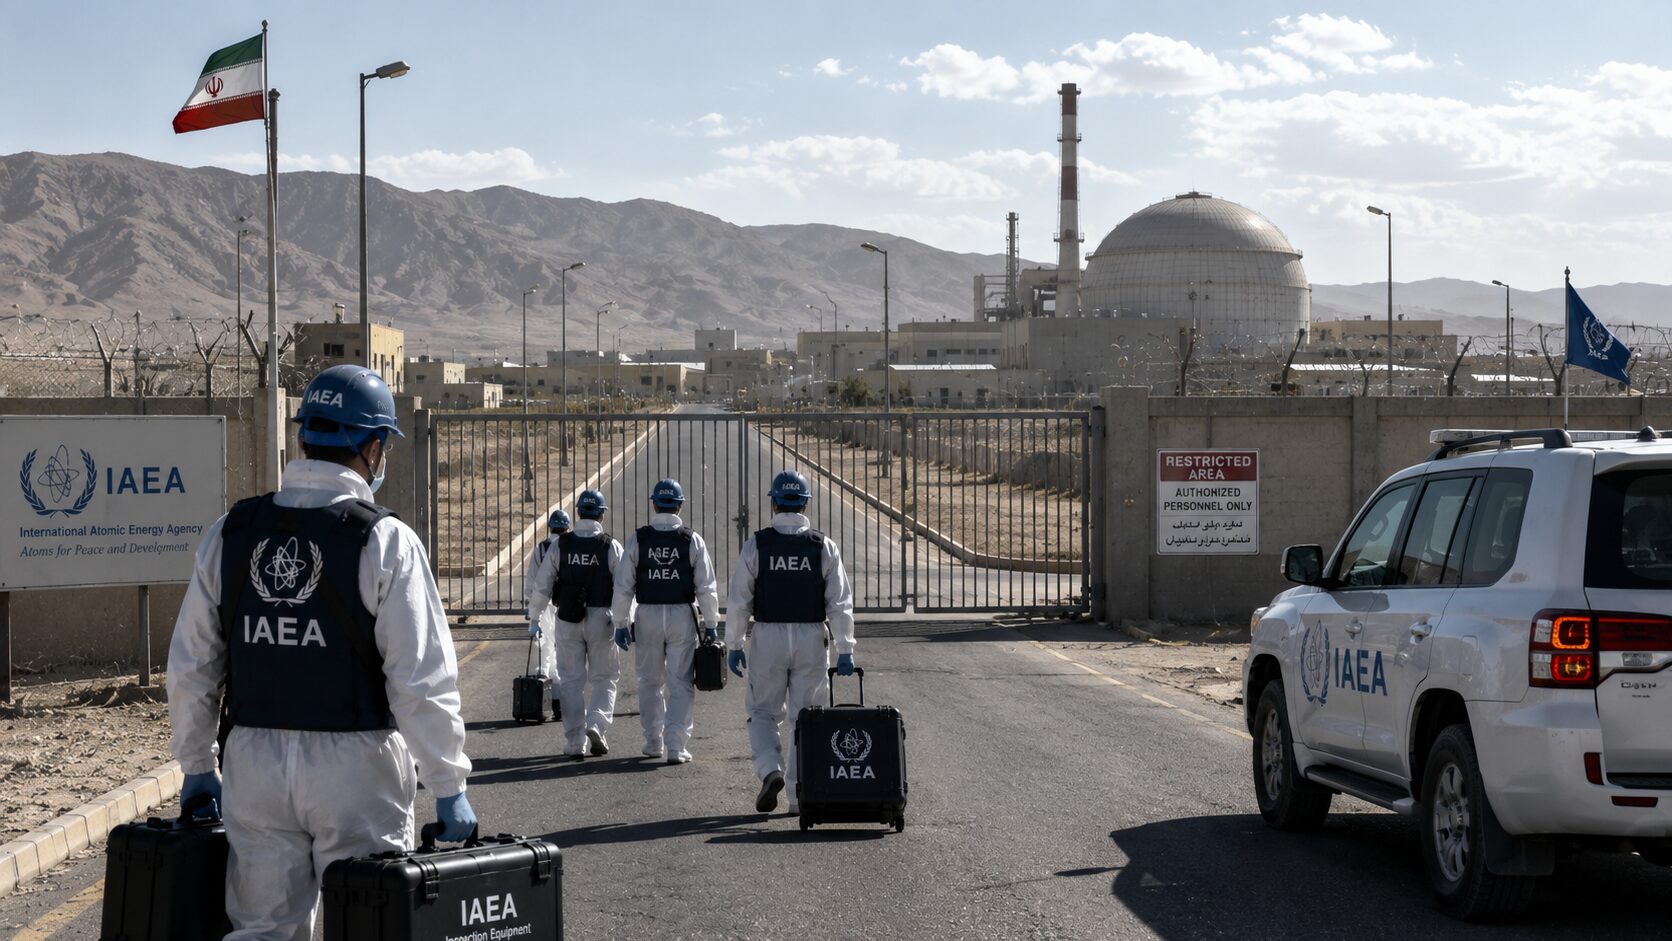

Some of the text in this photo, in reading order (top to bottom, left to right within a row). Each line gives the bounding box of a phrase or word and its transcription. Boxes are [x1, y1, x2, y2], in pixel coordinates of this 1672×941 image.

[306, 390, 343, 408] IAEA
[1166, 455, 1251, 467] RESTRICTED
[106, 466, 186, 495] IAEA
[1188, 469, 1225, 480] AREA
[1163, 501, 1252, 511] PERSONNEL ONLY
[20, 523, 203, 538] International Atomic Energy Agency
[20, 546, 54, 558] Atoms
[54, 544, 72, 559] for
[74, 543, 105, 556] Peace
[106, 542, 127, 555] and
[568, 553, 600, 566] IAEA
[769, 555, 812, 571] IAEA
[648, 568, 680, 580] IAEA
[244, 615, 327, 647] IAEA
[1334, 647, 1388, 696] IAEA
[830, 765, 876, 779] IAEA
[461, 893, 518, 926] IAEA
